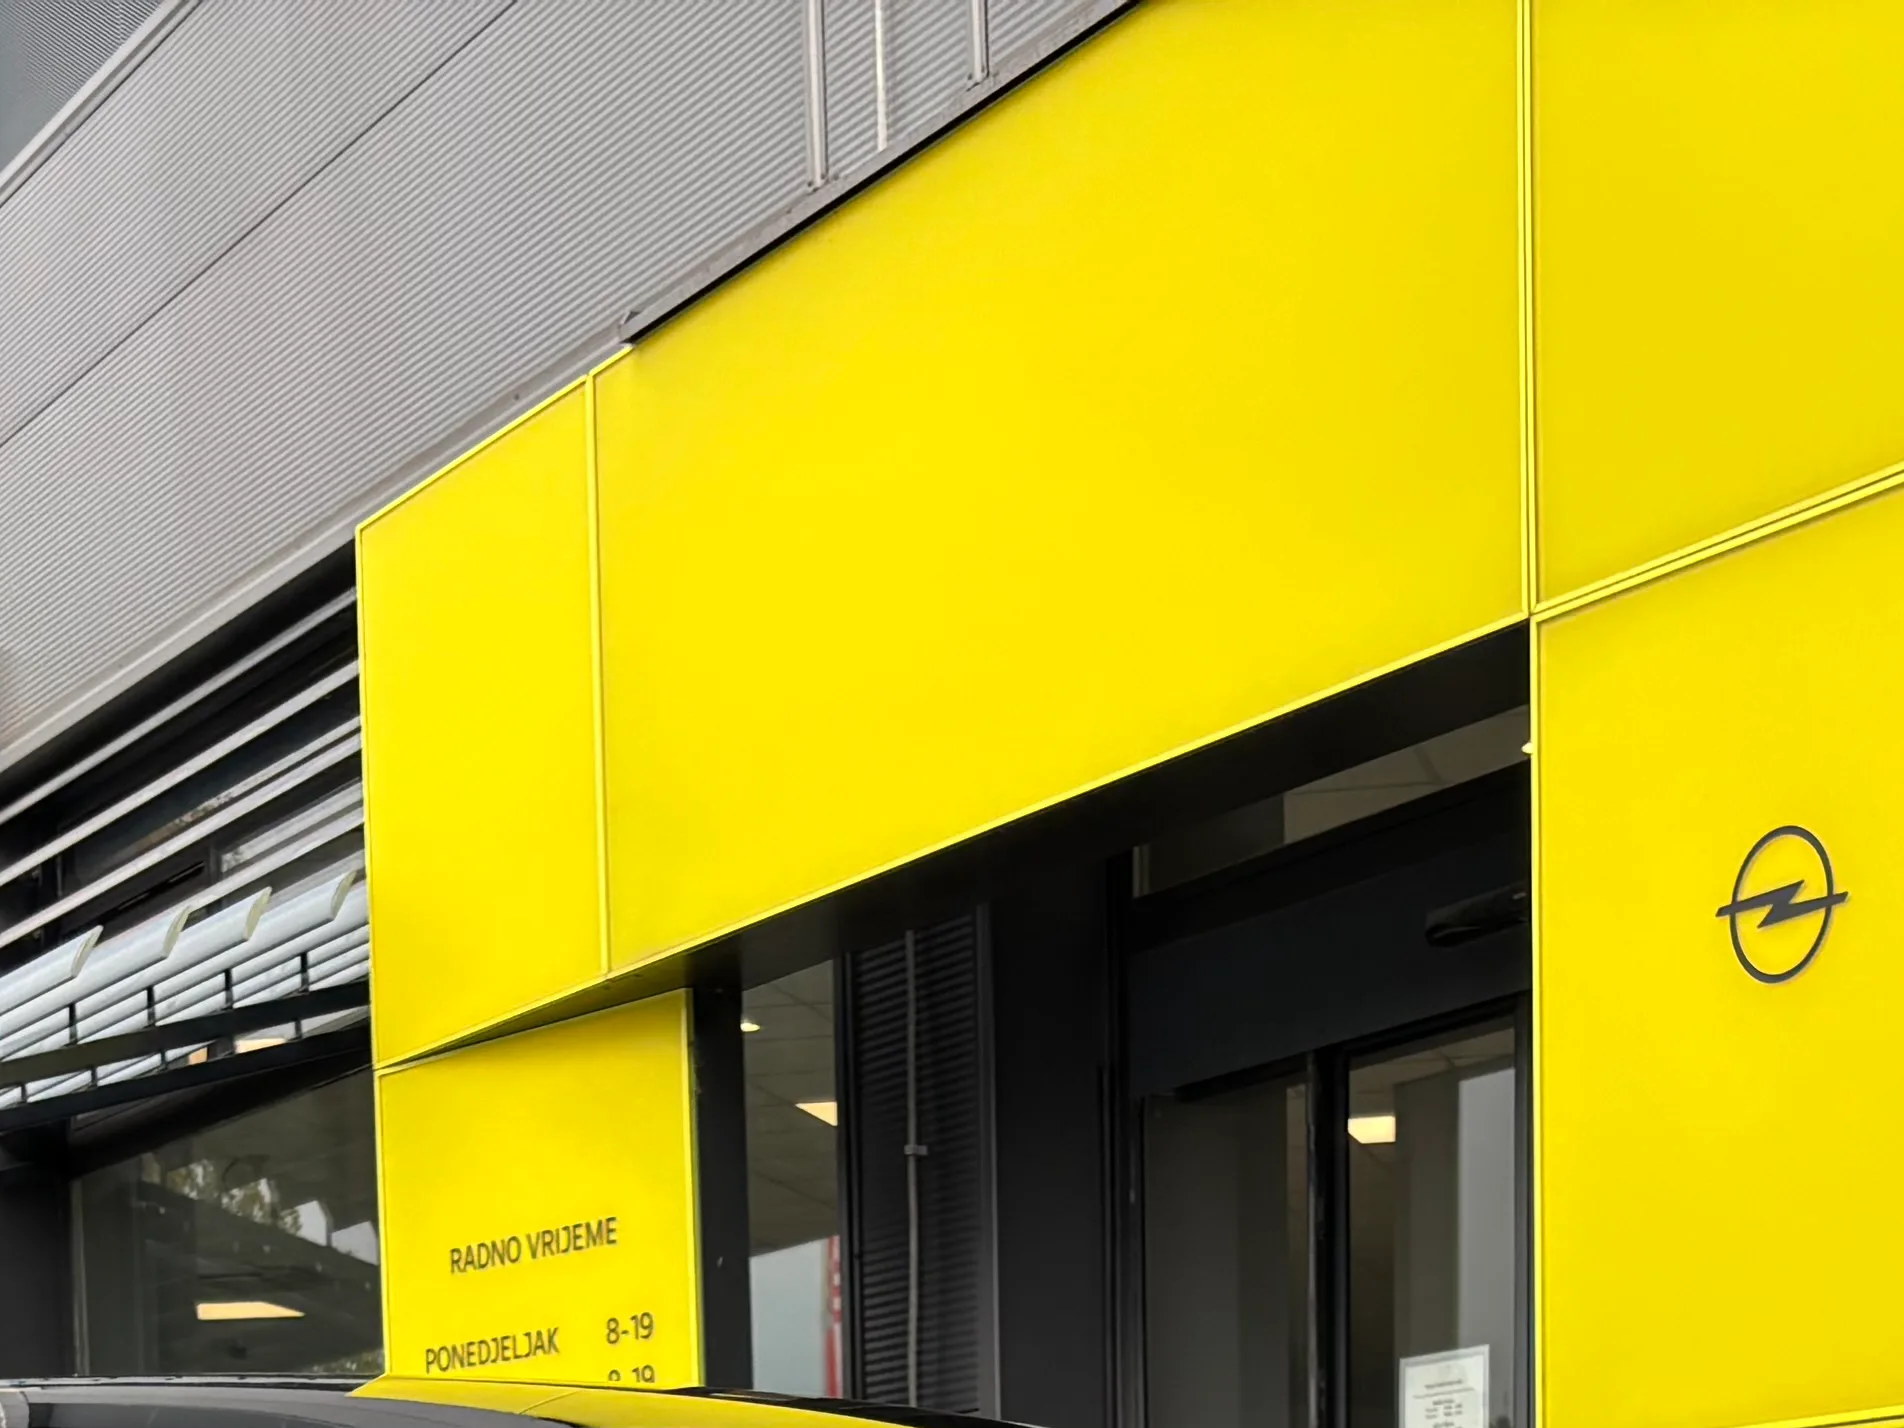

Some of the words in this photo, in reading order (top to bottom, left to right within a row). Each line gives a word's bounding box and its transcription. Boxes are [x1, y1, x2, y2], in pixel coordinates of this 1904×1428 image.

[449, 1235, 522, 1275] RADNO
[526, 1216, 618, 1260] VRIJEME
[425, 1327, 560, 1374] PONEDJELJAK
[606, 1312, 654, 1345] 8-19
